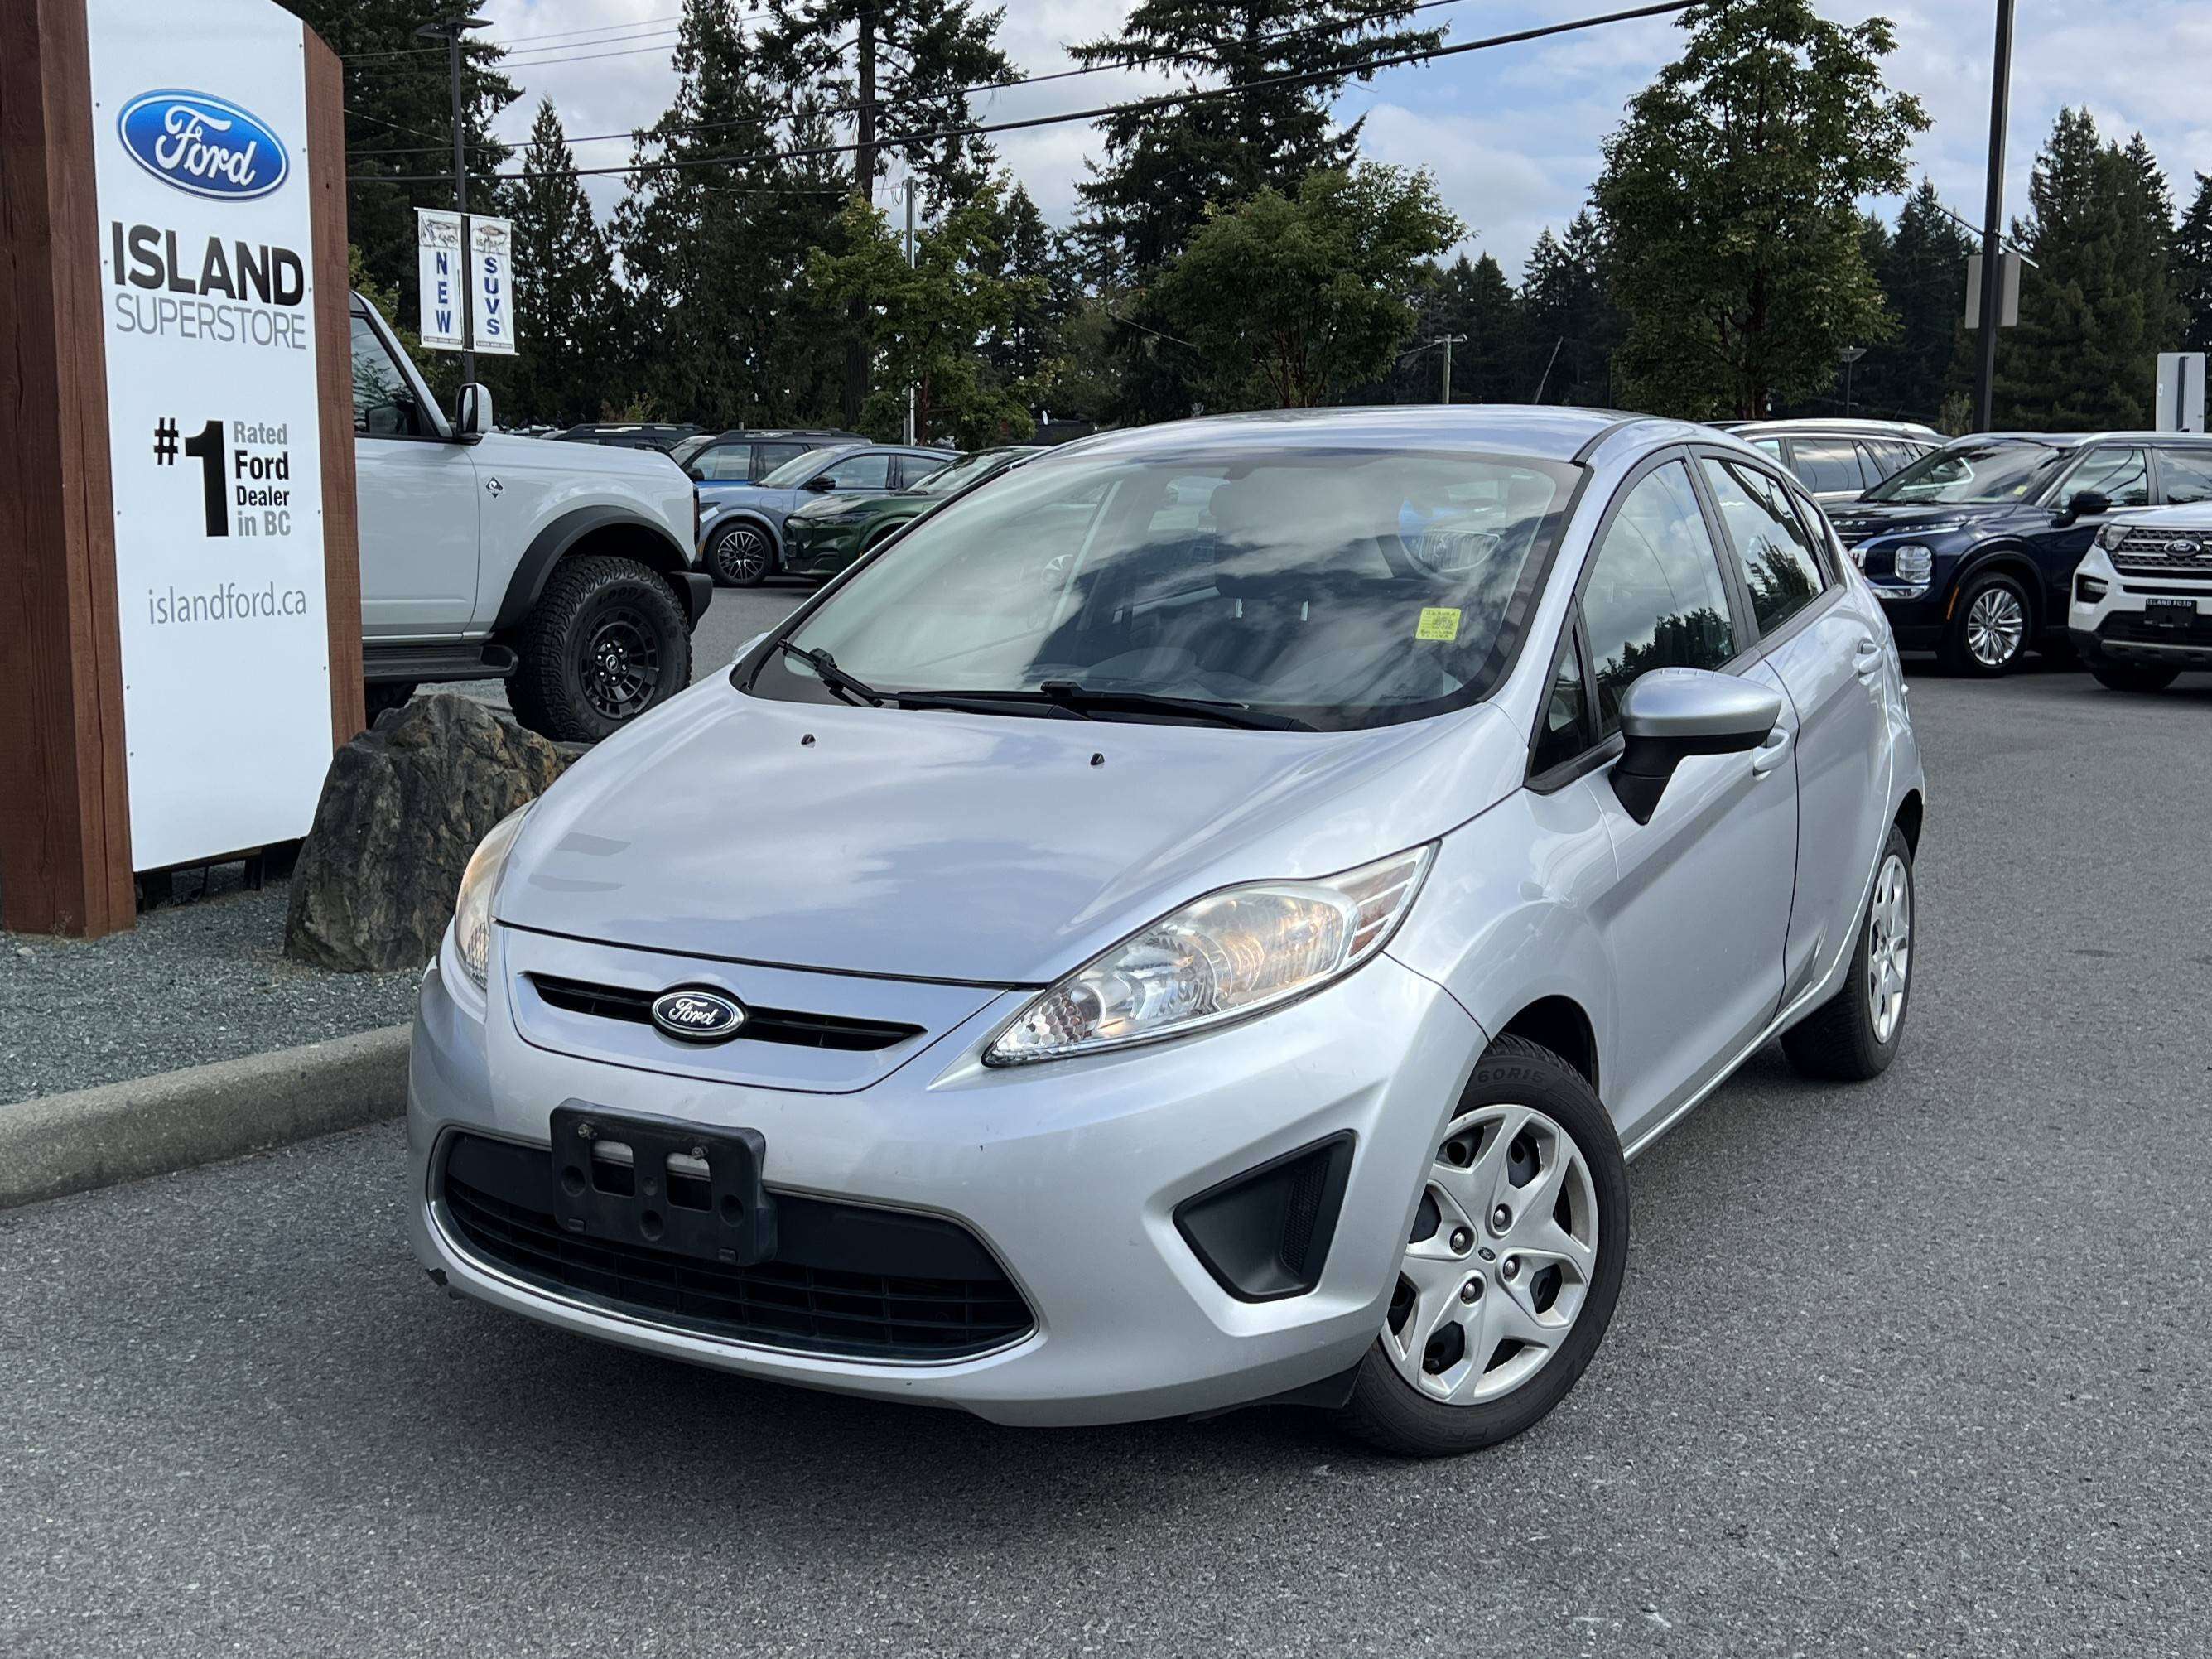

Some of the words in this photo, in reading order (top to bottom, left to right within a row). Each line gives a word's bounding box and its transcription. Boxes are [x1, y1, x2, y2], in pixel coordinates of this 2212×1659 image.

[155, 105, 257, 186] Ford
[111, 221, 304, 306] ISLAND
[436, 251, 451, 334] NEW
[115, 292, 306, 349] SUPERSTORE
[233, 421, 288, 446] Rated
[153, 417, 229, 537] #1
[234, 449, 290, 480] Ford
[236, 485, 290, 506] Dealer
[237, 510, 257, 537] in
[264, 510, 291, 536] BC
[148, 581, 306, 624] islandford.ca
[668, 998, 719, 1025] Ford
